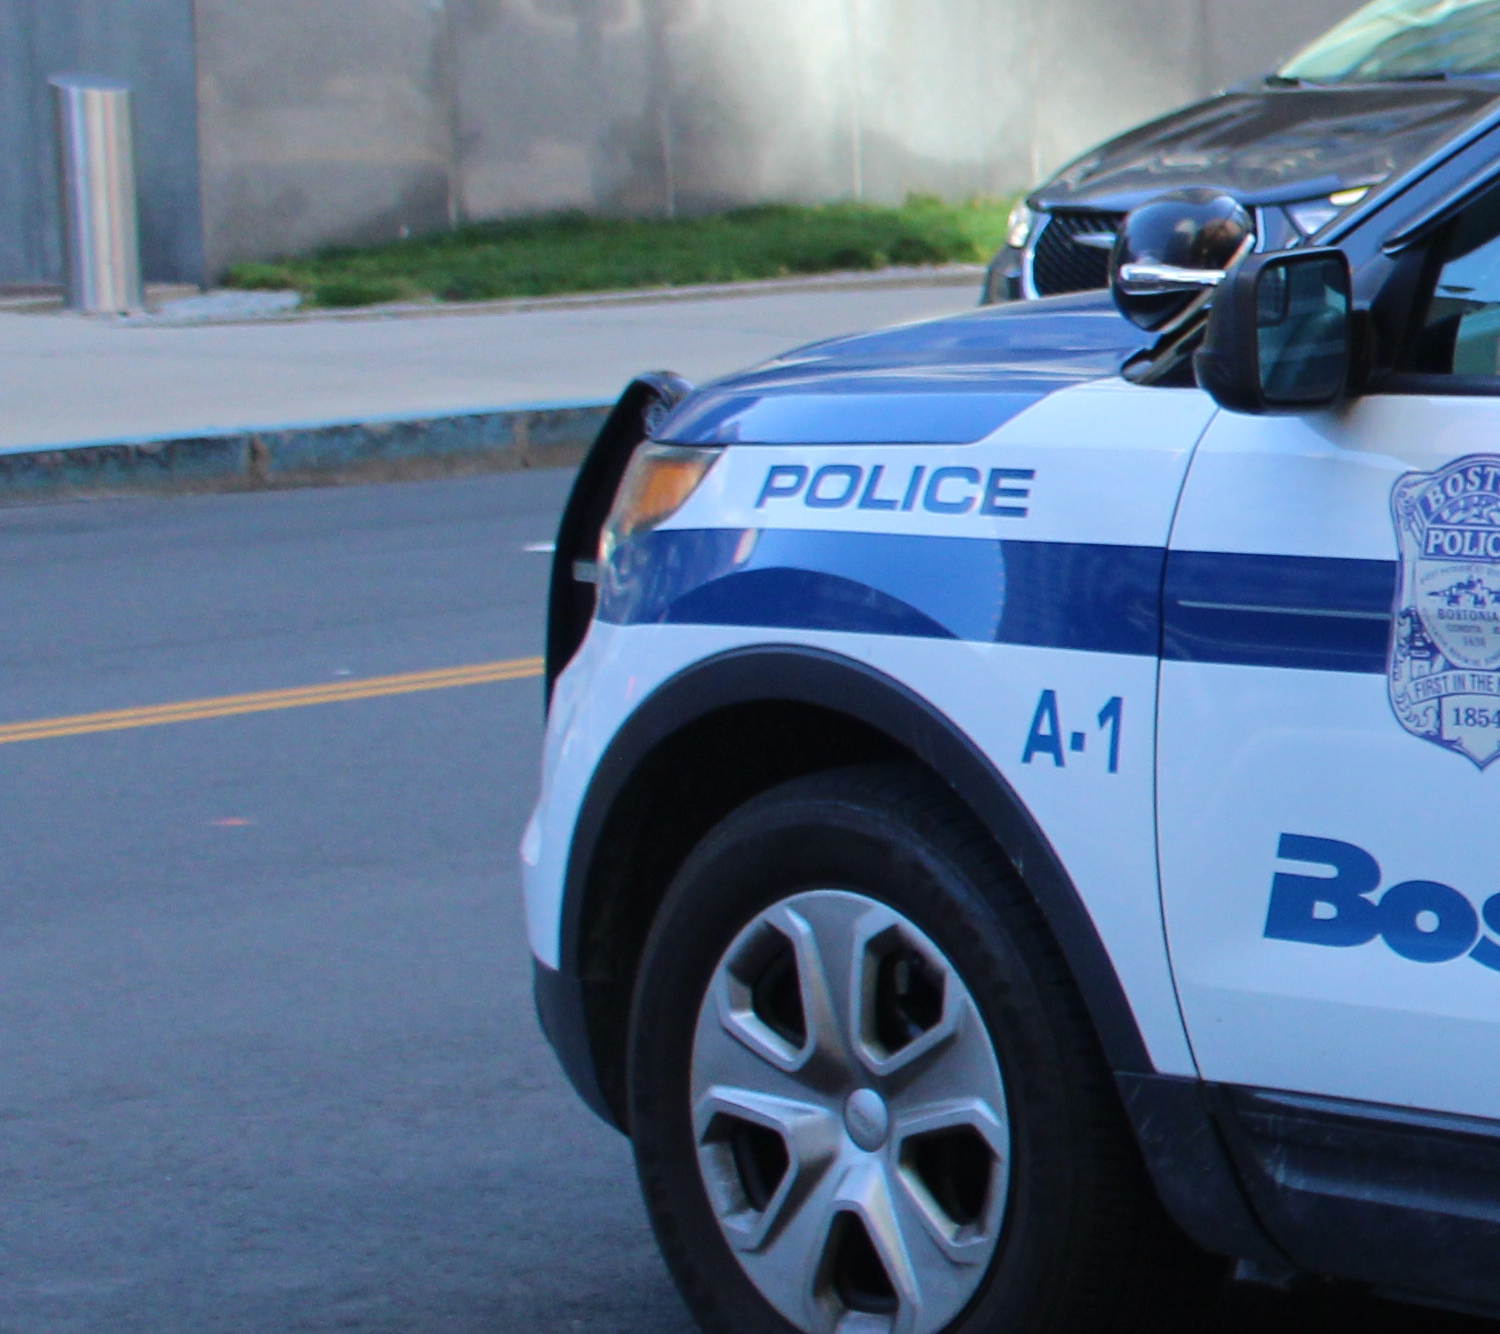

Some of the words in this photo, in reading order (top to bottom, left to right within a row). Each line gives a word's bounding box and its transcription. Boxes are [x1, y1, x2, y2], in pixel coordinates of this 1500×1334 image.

[754, 464, 1036, 519] POLICE
[1414, 675, 1448, 700] FIRST
[1452, 673, 1467, 691] IN
[1470, 673, 1495, 693] THE
[1021, 688, 1125, 774] A-1
